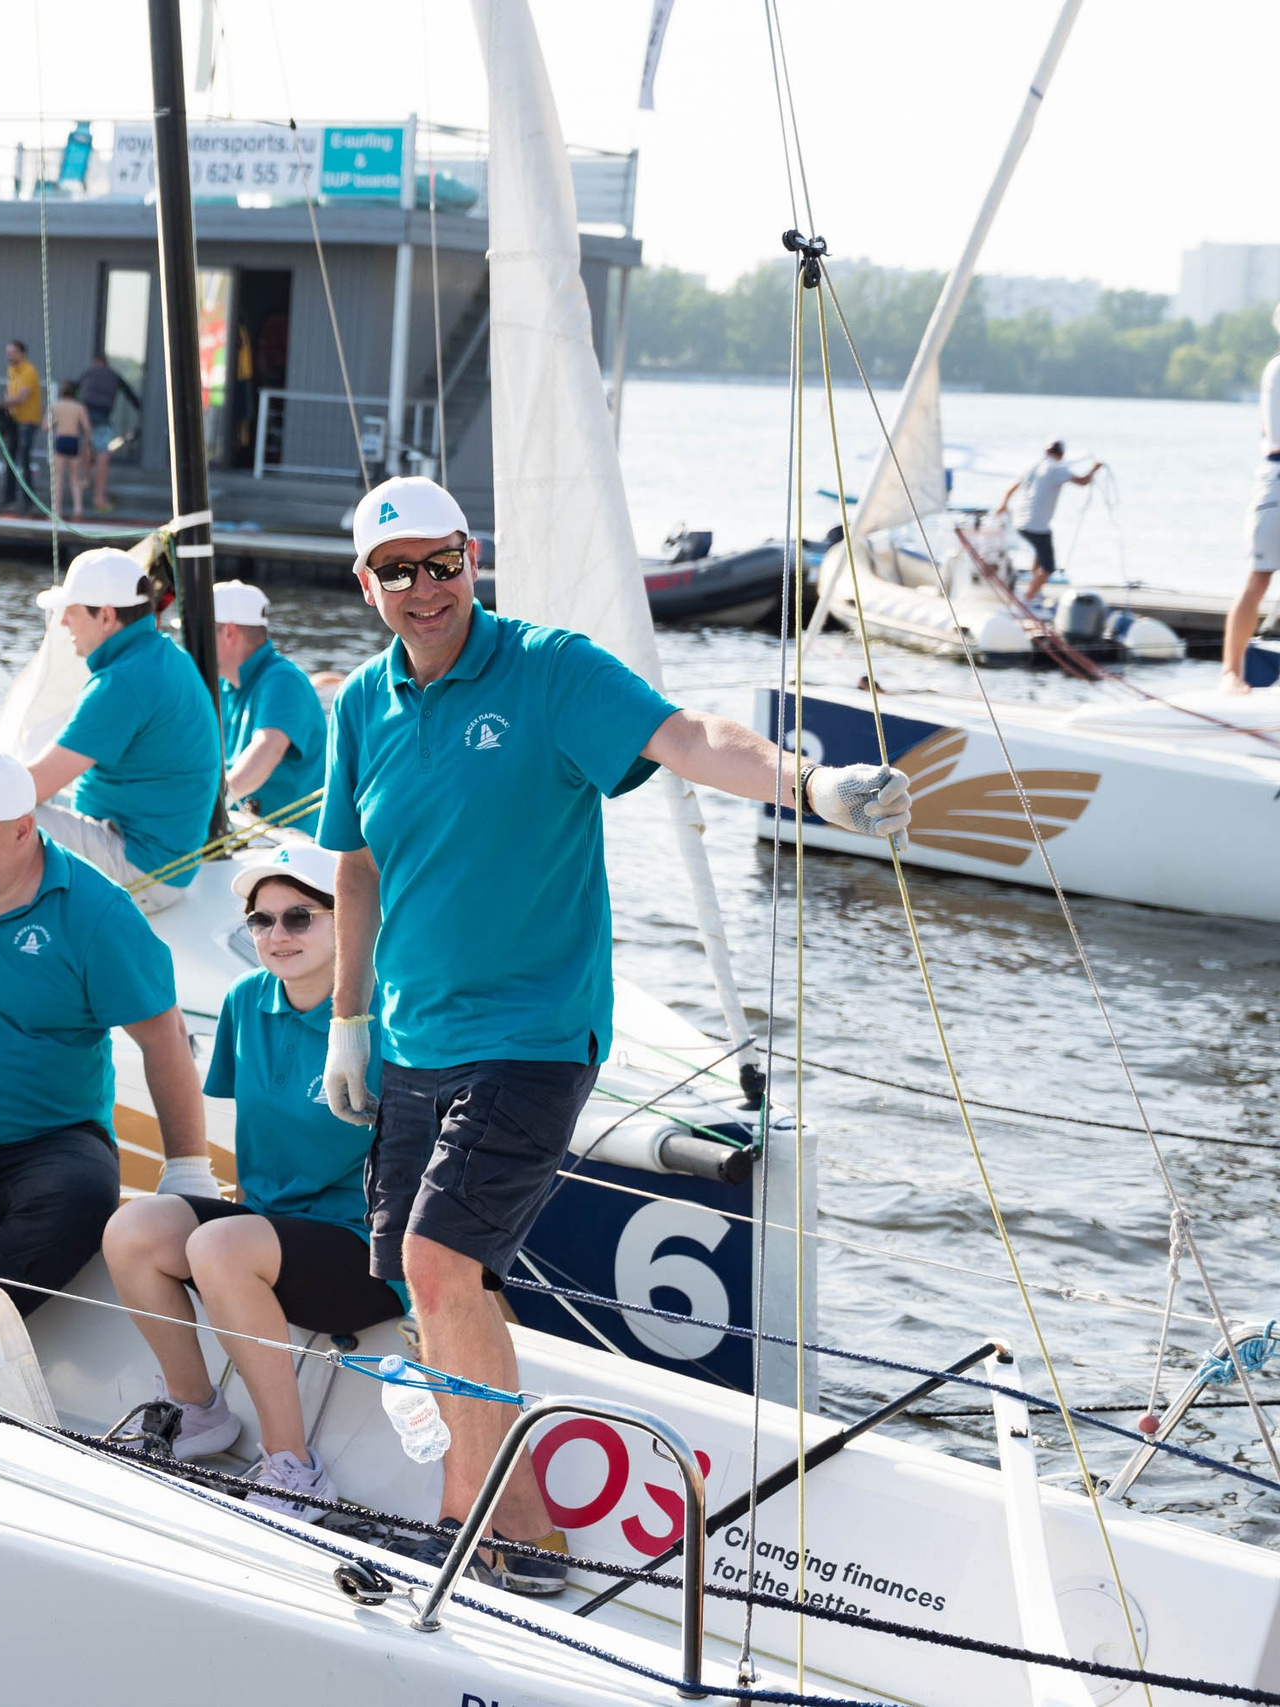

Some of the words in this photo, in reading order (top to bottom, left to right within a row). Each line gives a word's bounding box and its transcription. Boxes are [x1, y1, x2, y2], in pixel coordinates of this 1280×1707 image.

[207, 162, 244, 184] 624
[252, 162, 279, 184] 55
[287, 162, 313, 184] 77
[614, 1198, 732, 1361] 6
[712, 1556, 748, 1583] for
[752, 1569, 789, 1597] the
[724, 1526, 838, 1582] Changing
[841, 1562, 946, 1612] finances
